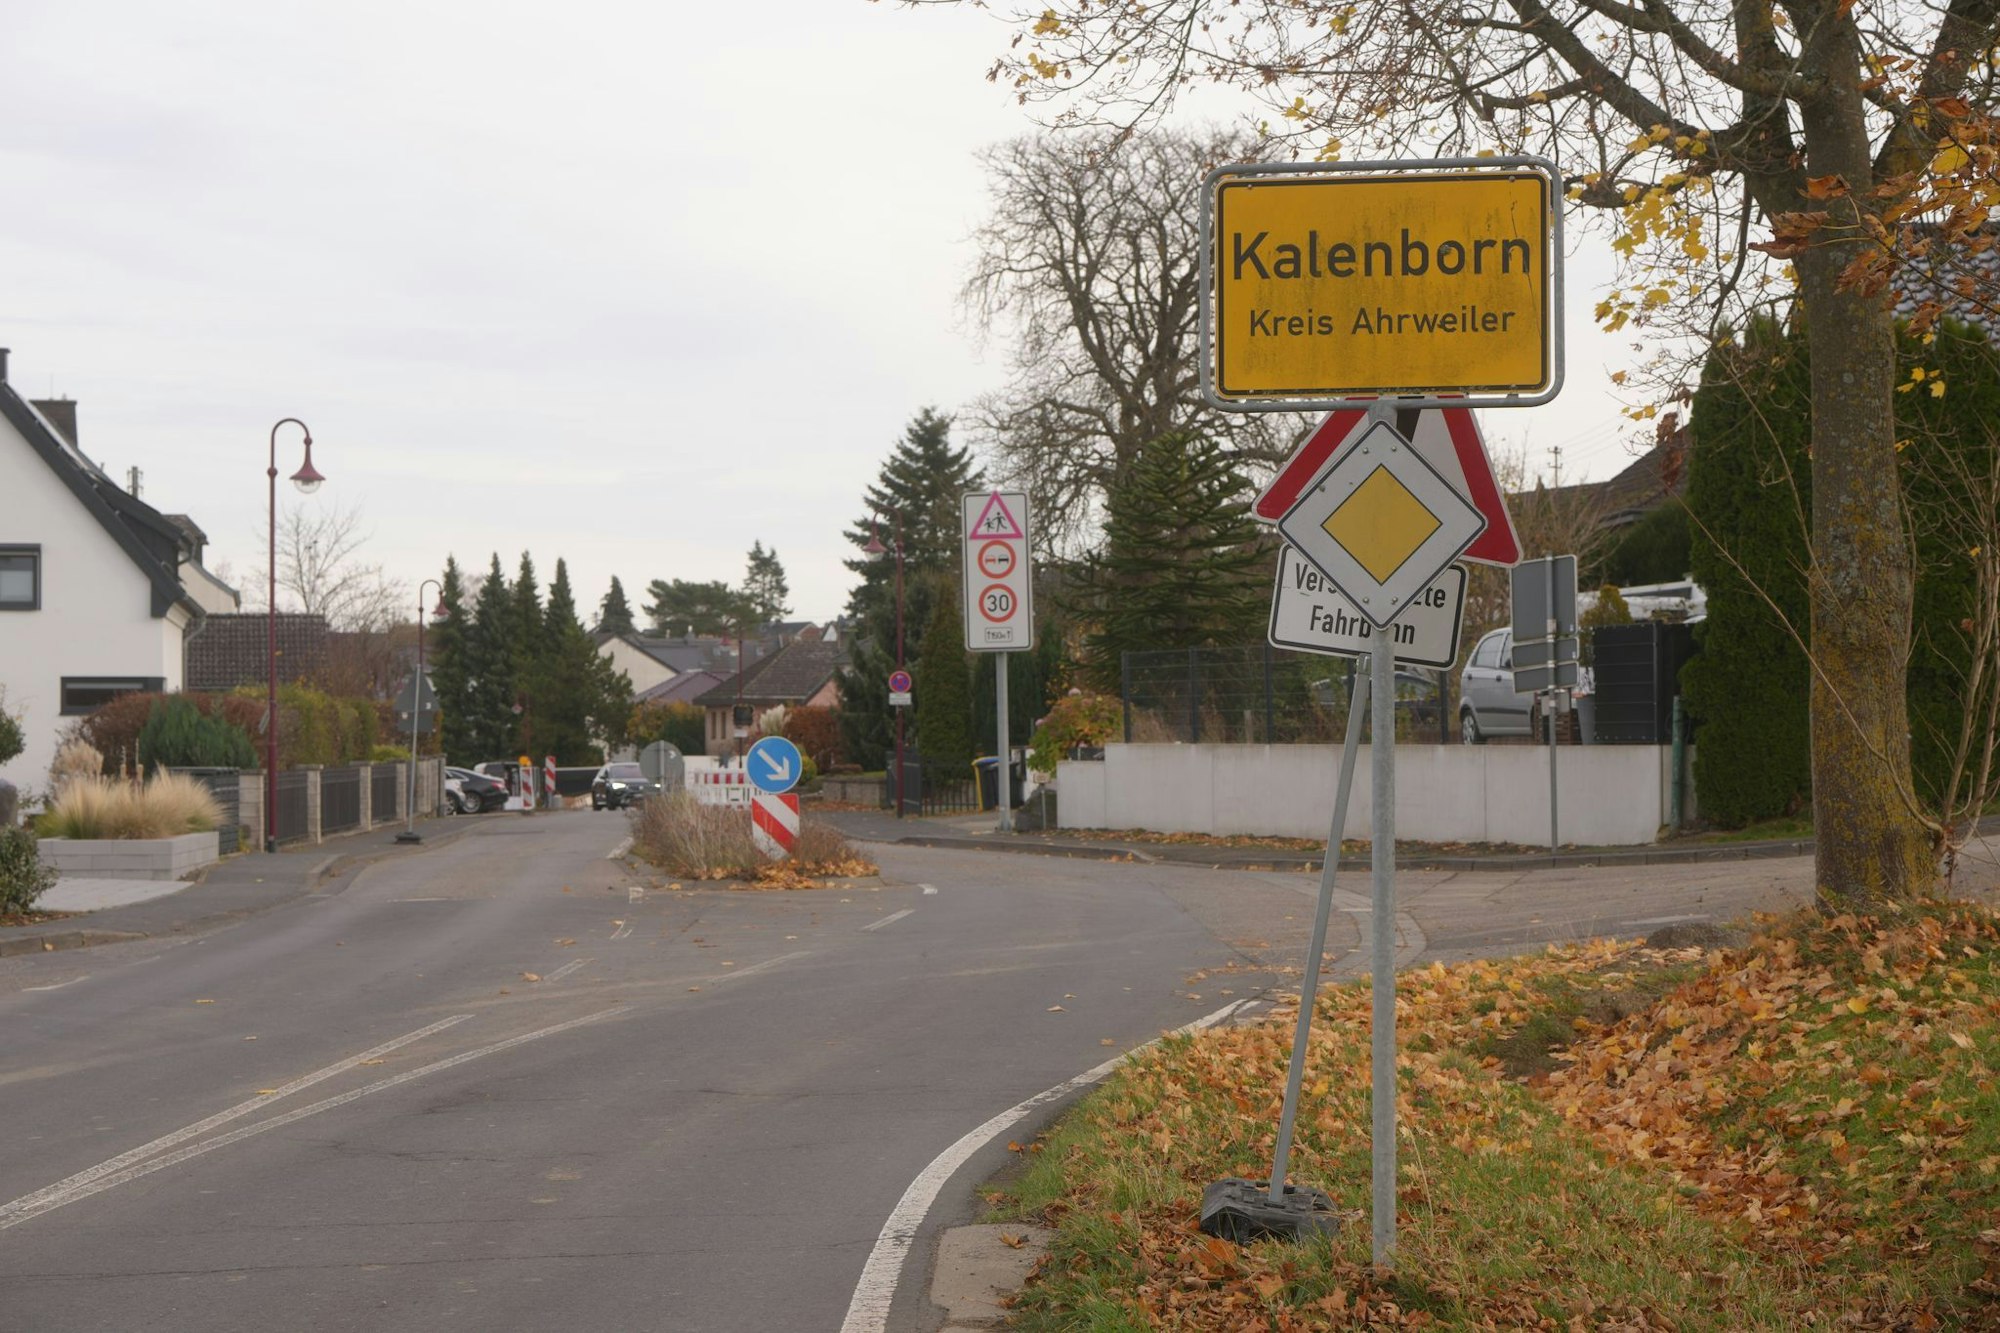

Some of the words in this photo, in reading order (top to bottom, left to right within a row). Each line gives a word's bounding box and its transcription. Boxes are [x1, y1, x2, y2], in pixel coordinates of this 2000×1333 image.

[1233, 228, 1530, 280] Kalenborn
[1249, 308, 1333, 337] Kreis
[1351, 305, 1516, 336] Ahrweiler
[987, 594, 1009, 612] 30
[1310, 605, 1416, 645] Fahrbn
